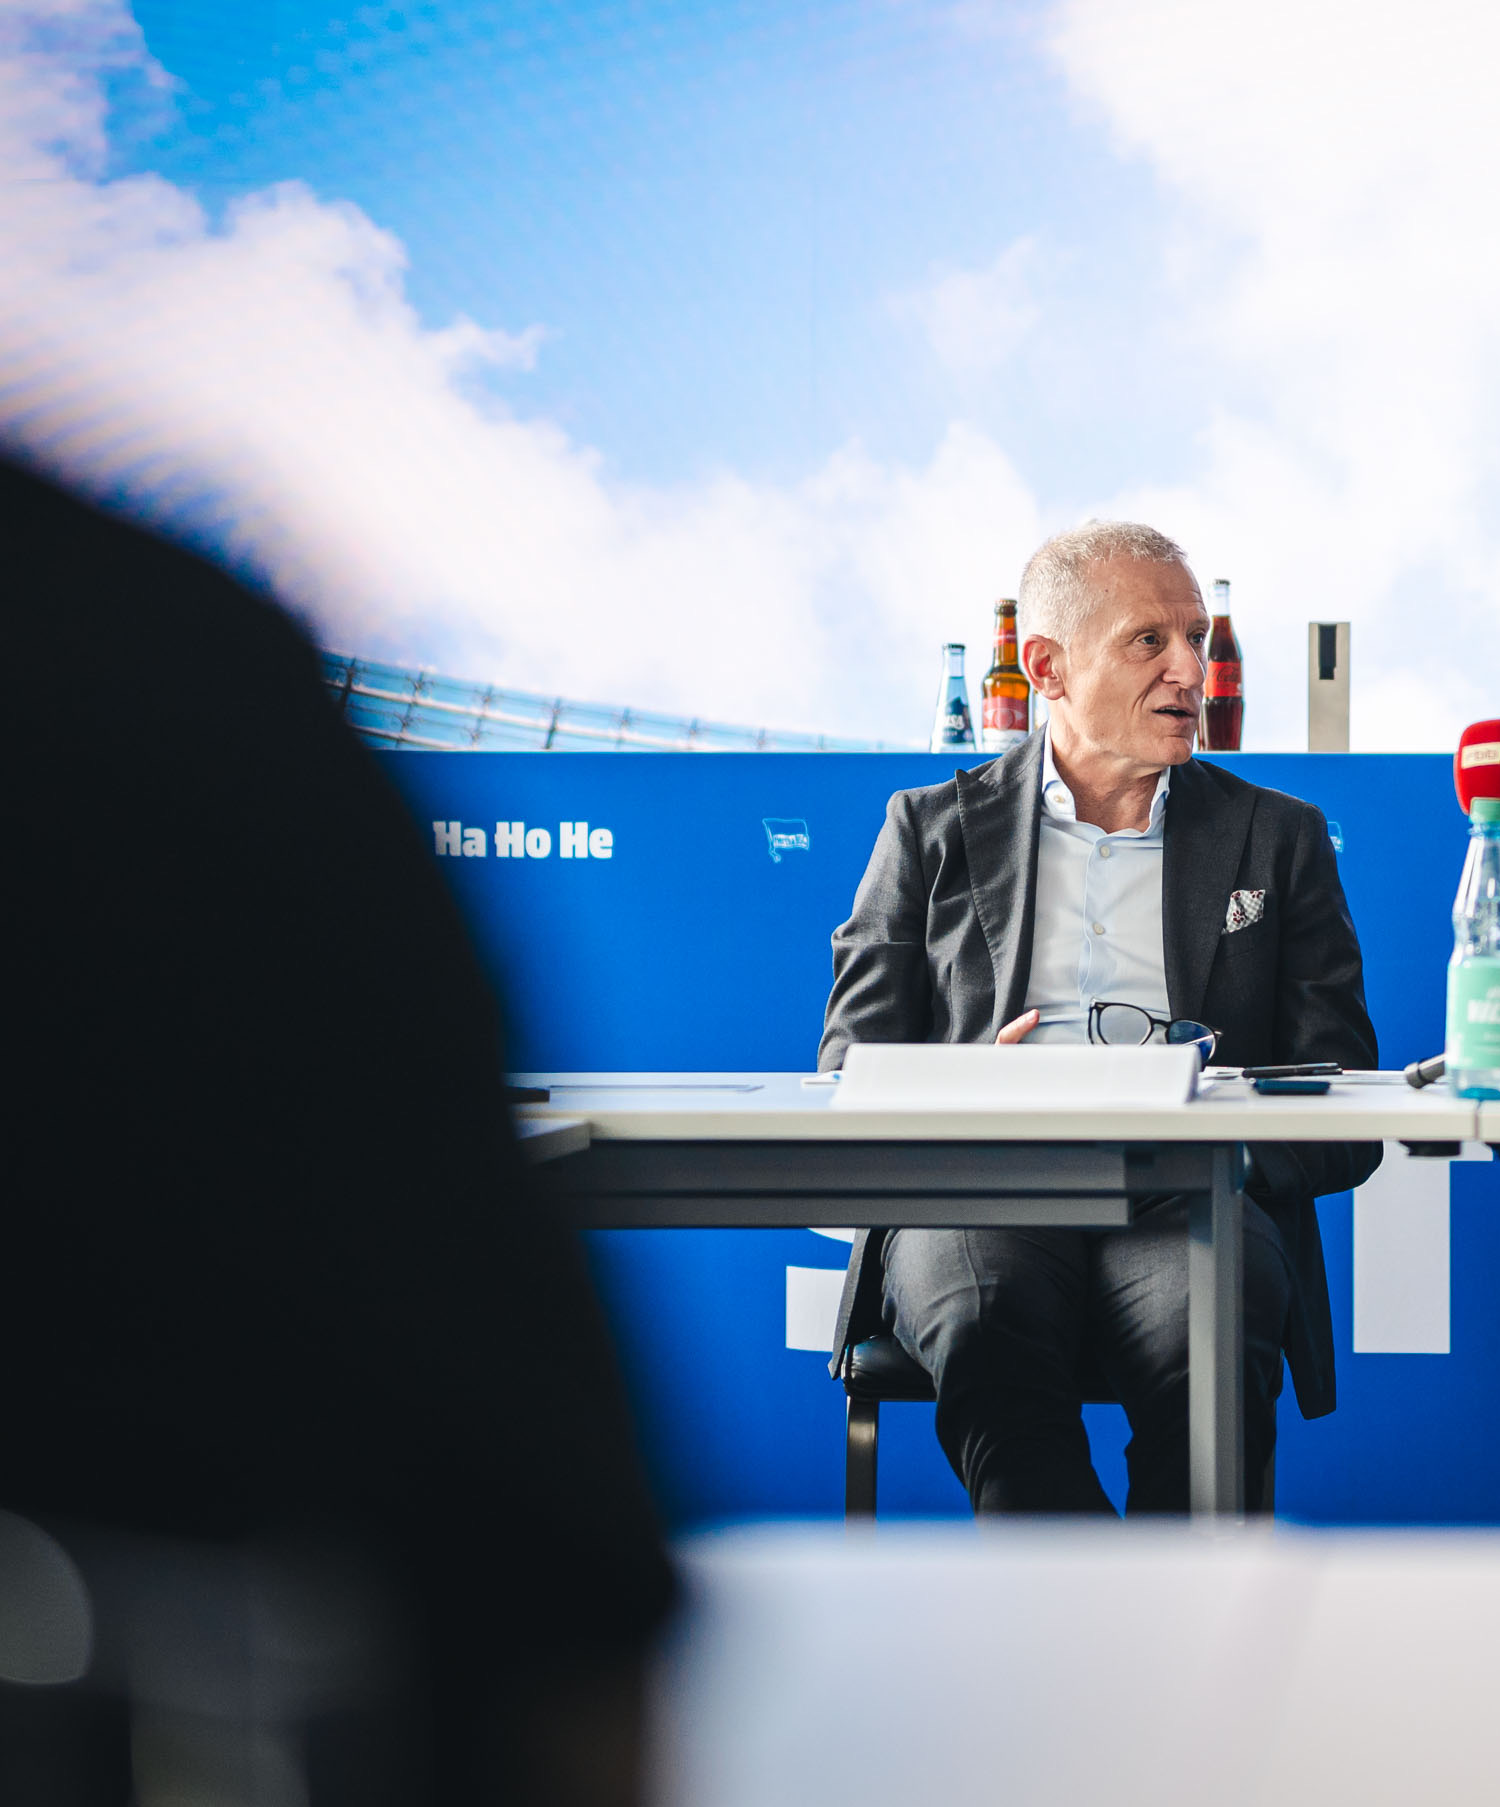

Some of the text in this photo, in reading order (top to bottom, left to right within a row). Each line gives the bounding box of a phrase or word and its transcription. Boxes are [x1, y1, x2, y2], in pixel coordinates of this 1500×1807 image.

[432, 820, 613, 859] Ha Ho He
